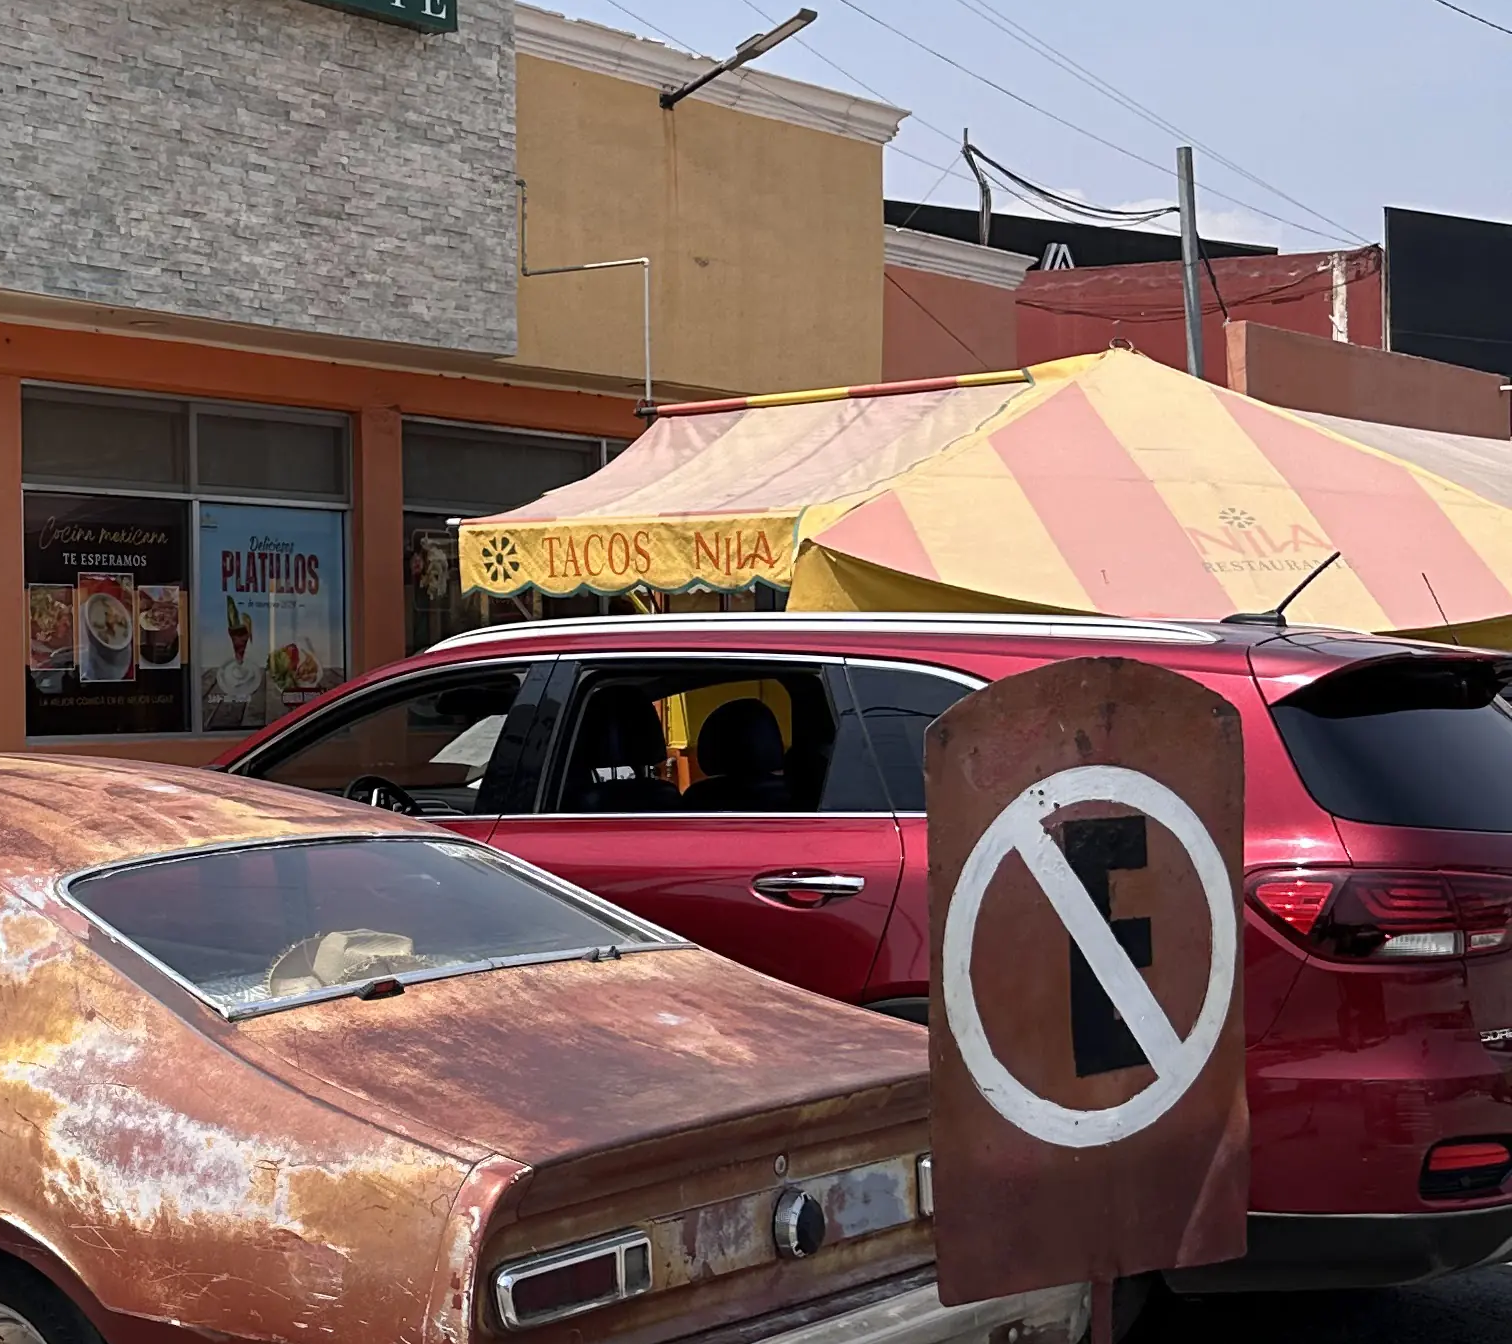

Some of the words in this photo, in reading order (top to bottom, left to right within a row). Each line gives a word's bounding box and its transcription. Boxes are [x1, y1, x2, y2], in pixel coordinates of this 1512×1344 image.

[39, 516, 96, 550] Cocina
[541, 530, 652, 578] TACOS
[693, 530, 784, 576] NILA
[62, 552, 78, 566] TE
[80, 553, 148, 567] ESPERAMOS
[221, 549, 320, 595] PLATILLOS
[1063, 815, 1154, 1078] E
